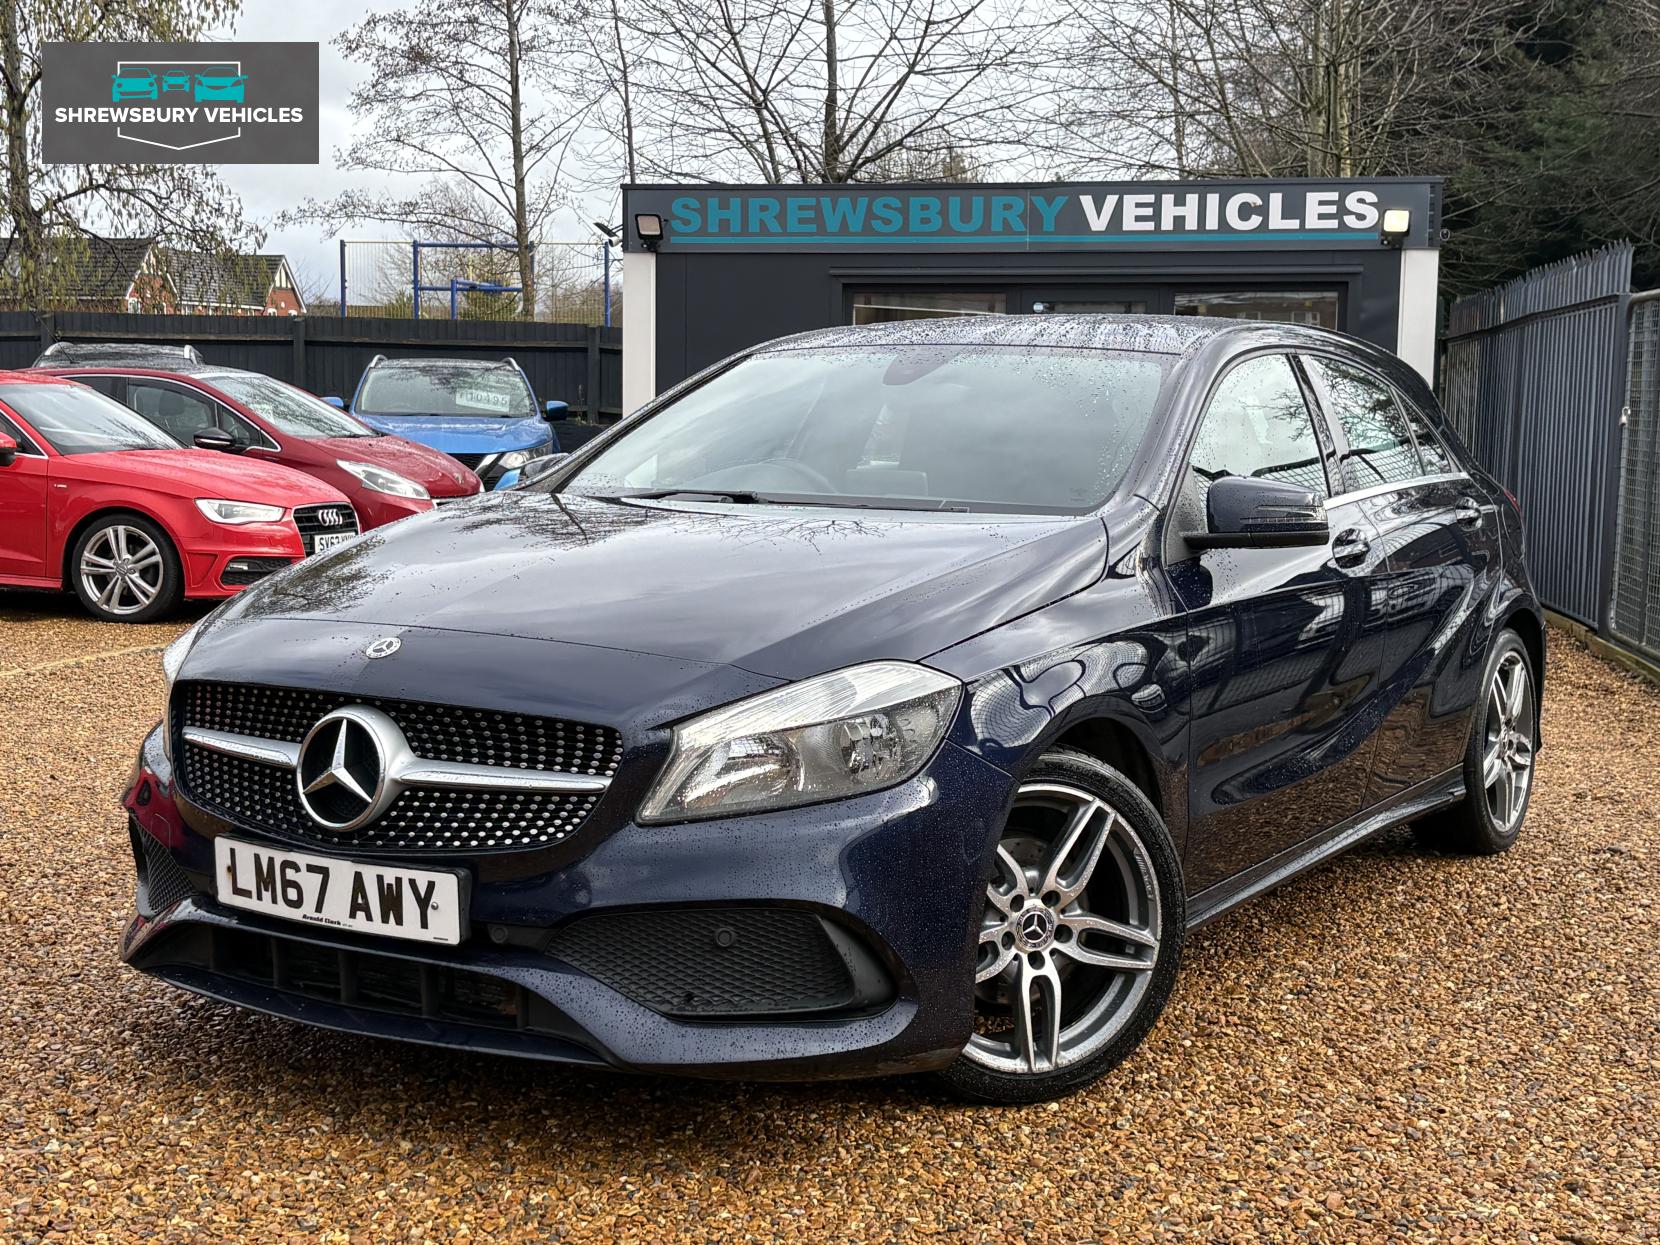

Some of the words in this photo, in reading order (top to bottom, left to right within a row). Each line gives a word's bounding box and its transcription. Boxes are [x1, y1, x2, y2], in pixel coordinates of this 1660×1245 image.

[671, 195, 1068, 233] SHREWSBURY
[1079, 190, 1380, 232] VEHICLES
[229, 847, 330, 913] LM67
[349, 870, 436, 930] AWY
